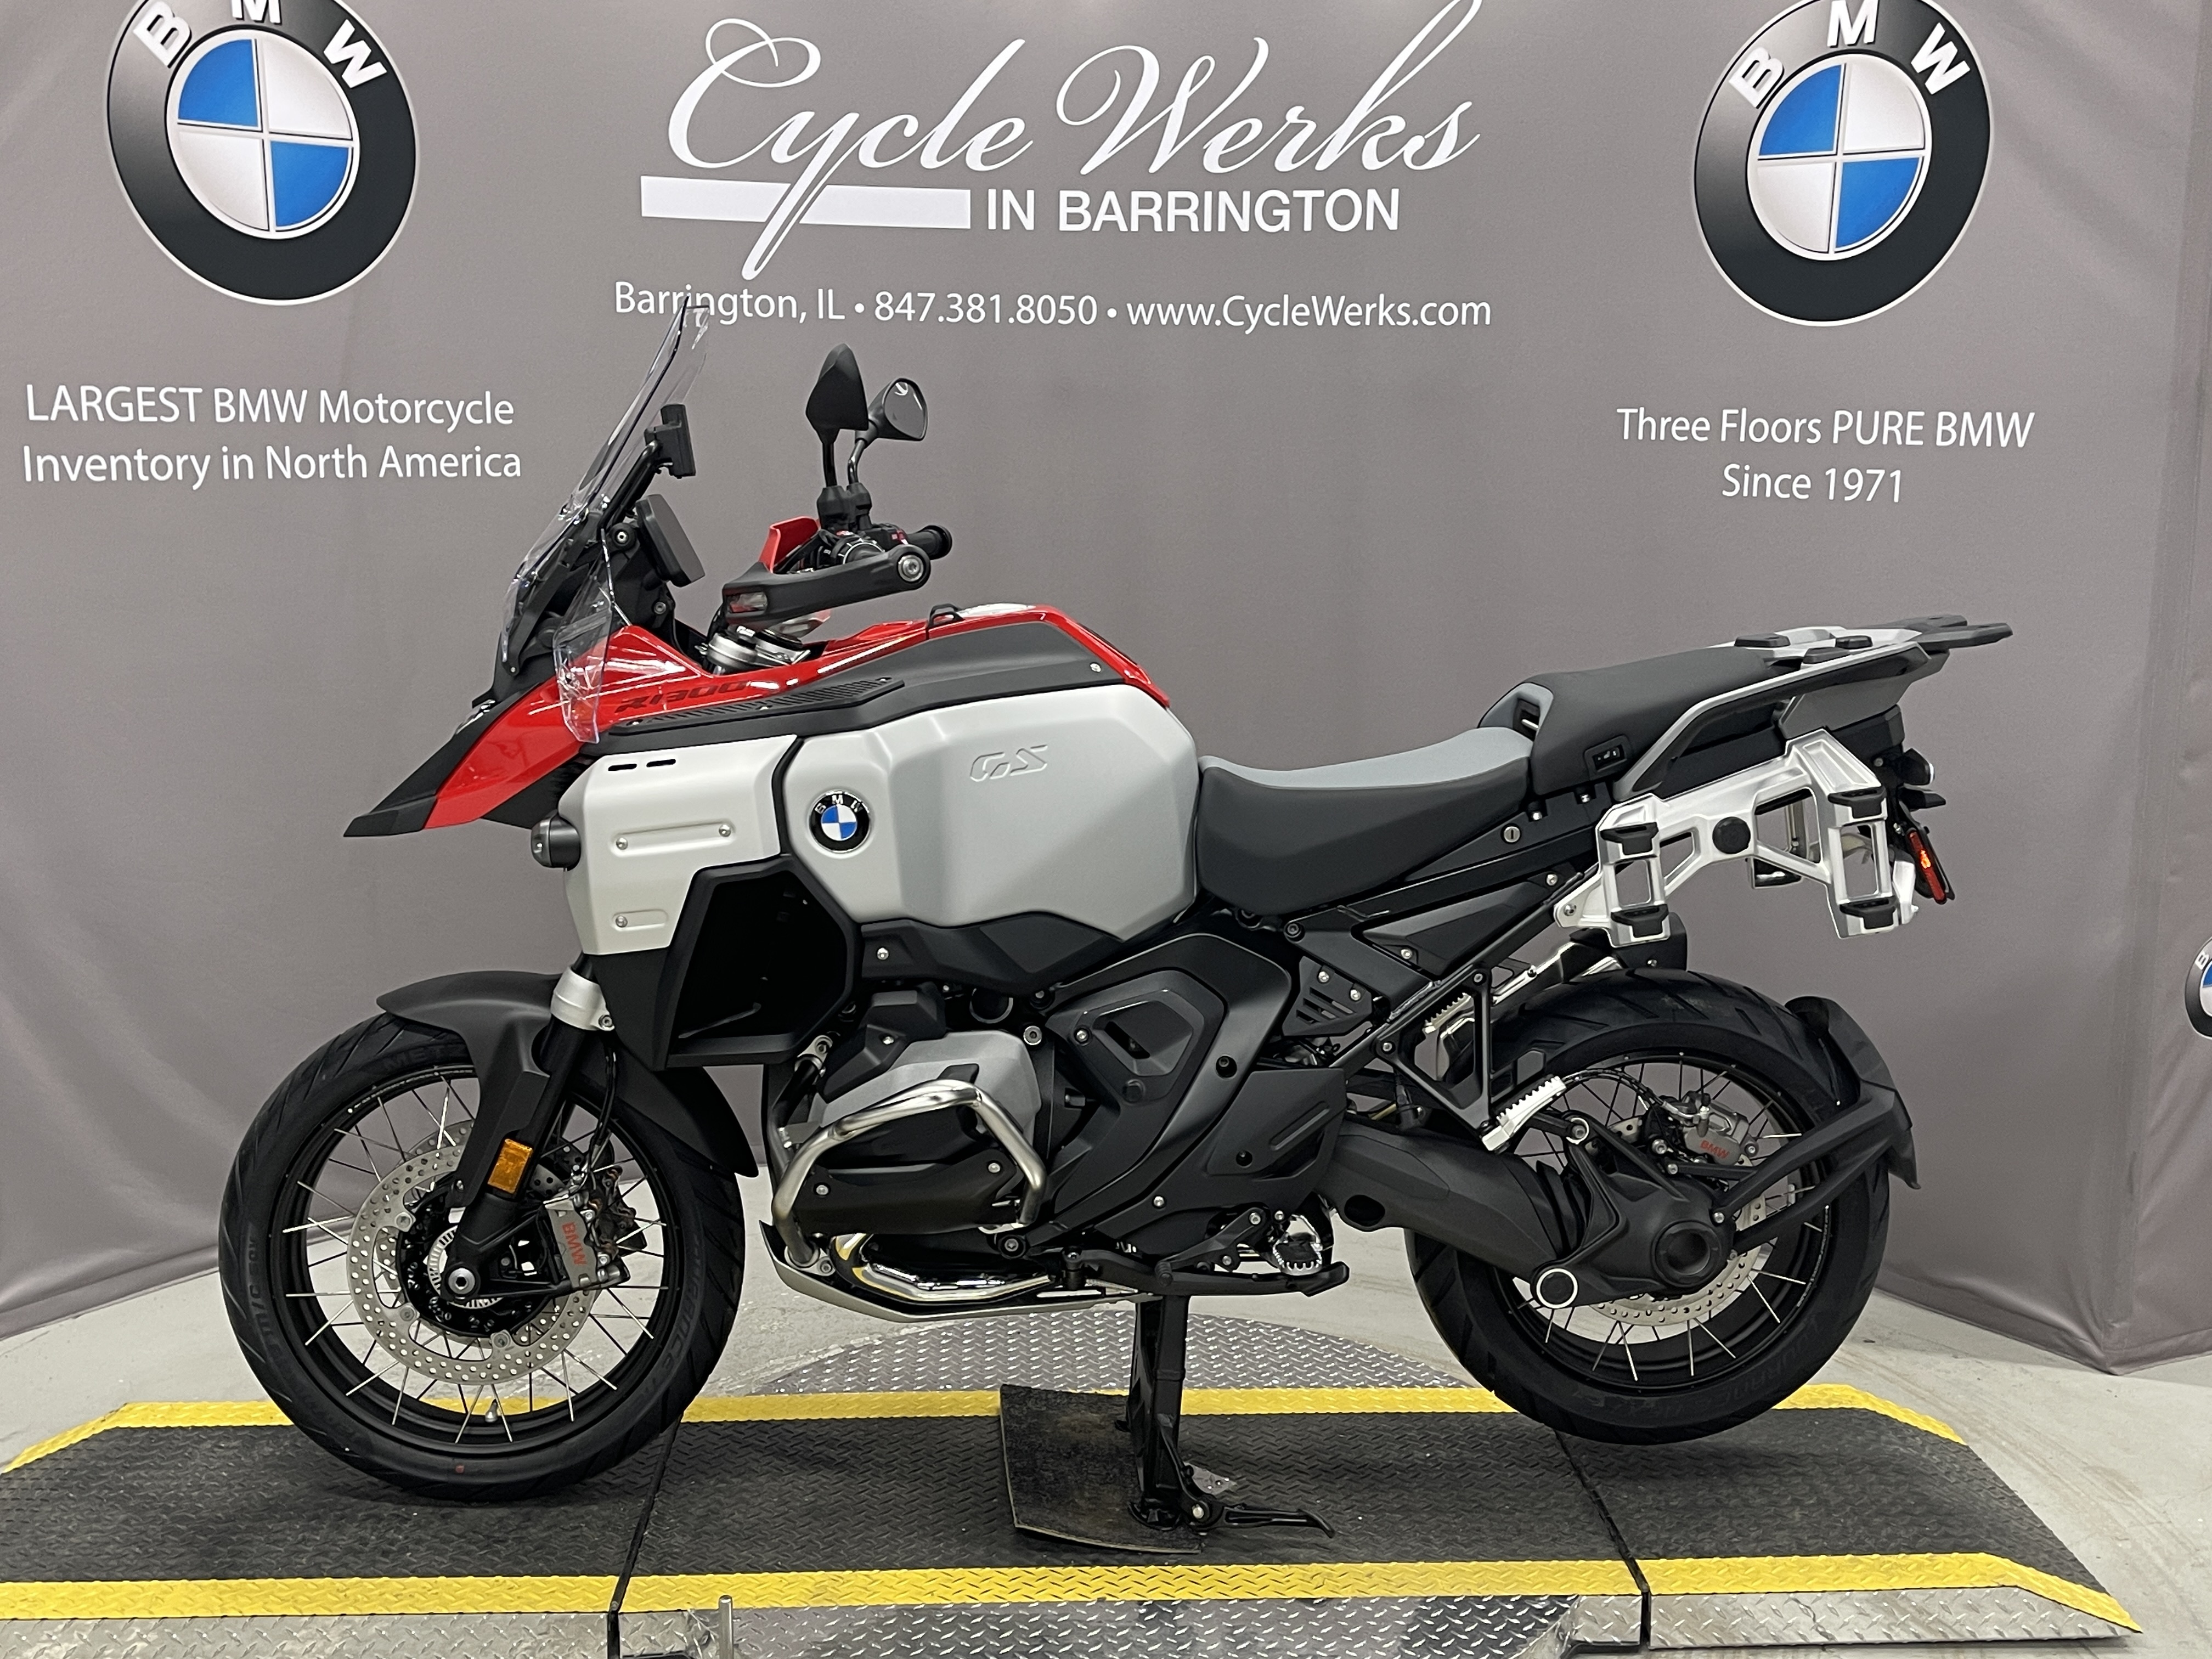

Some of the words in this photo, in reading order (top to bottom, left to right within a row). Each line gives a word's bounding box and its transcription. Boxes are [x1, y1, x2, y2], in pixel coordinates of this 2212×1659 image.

[1728, 0, 1971, 109] BMW
[668, 18, 1034, 280] Cycle
[1056, 0, 1483, 176] Werks
[988, 188, 1035, 231] IN
[1058, 188, 1400, 233] BARRINGTON
[615, 281, 805, 325] Barrington,
[817, 289, 845, 320] IL
[874, 291, 1098, 325] 847.381.8050
[1126, 293, 1491, 335] www.CycleWerks.com
[26, 384, 203, 422] LARGEST
[213, 388, 308, 423] BMW
[320, 390, 515, 433] Motorcycle
[1616, 407, 1711, 442] Three
[1720, 408, 1821, 444] Floors
[1833, 410, 1925, 445] PURE
[1936, 411, 2035, 448] BMW
[23, 445, 211, 490] Inventory
[222, 445, 254, 479] in
[266, 444, 368, 479] North
[379, 445, 521, 478] America
[1722, 464, 1812, 499] Since
[1825, 468, 1901, 503] 1971
[970, 744, 1048, 782] GS
[814, 794, 864, 815] BMW
[1700, 1139, 1730, 1159] BMW
[562, 1221, 588, 1266] BMW
